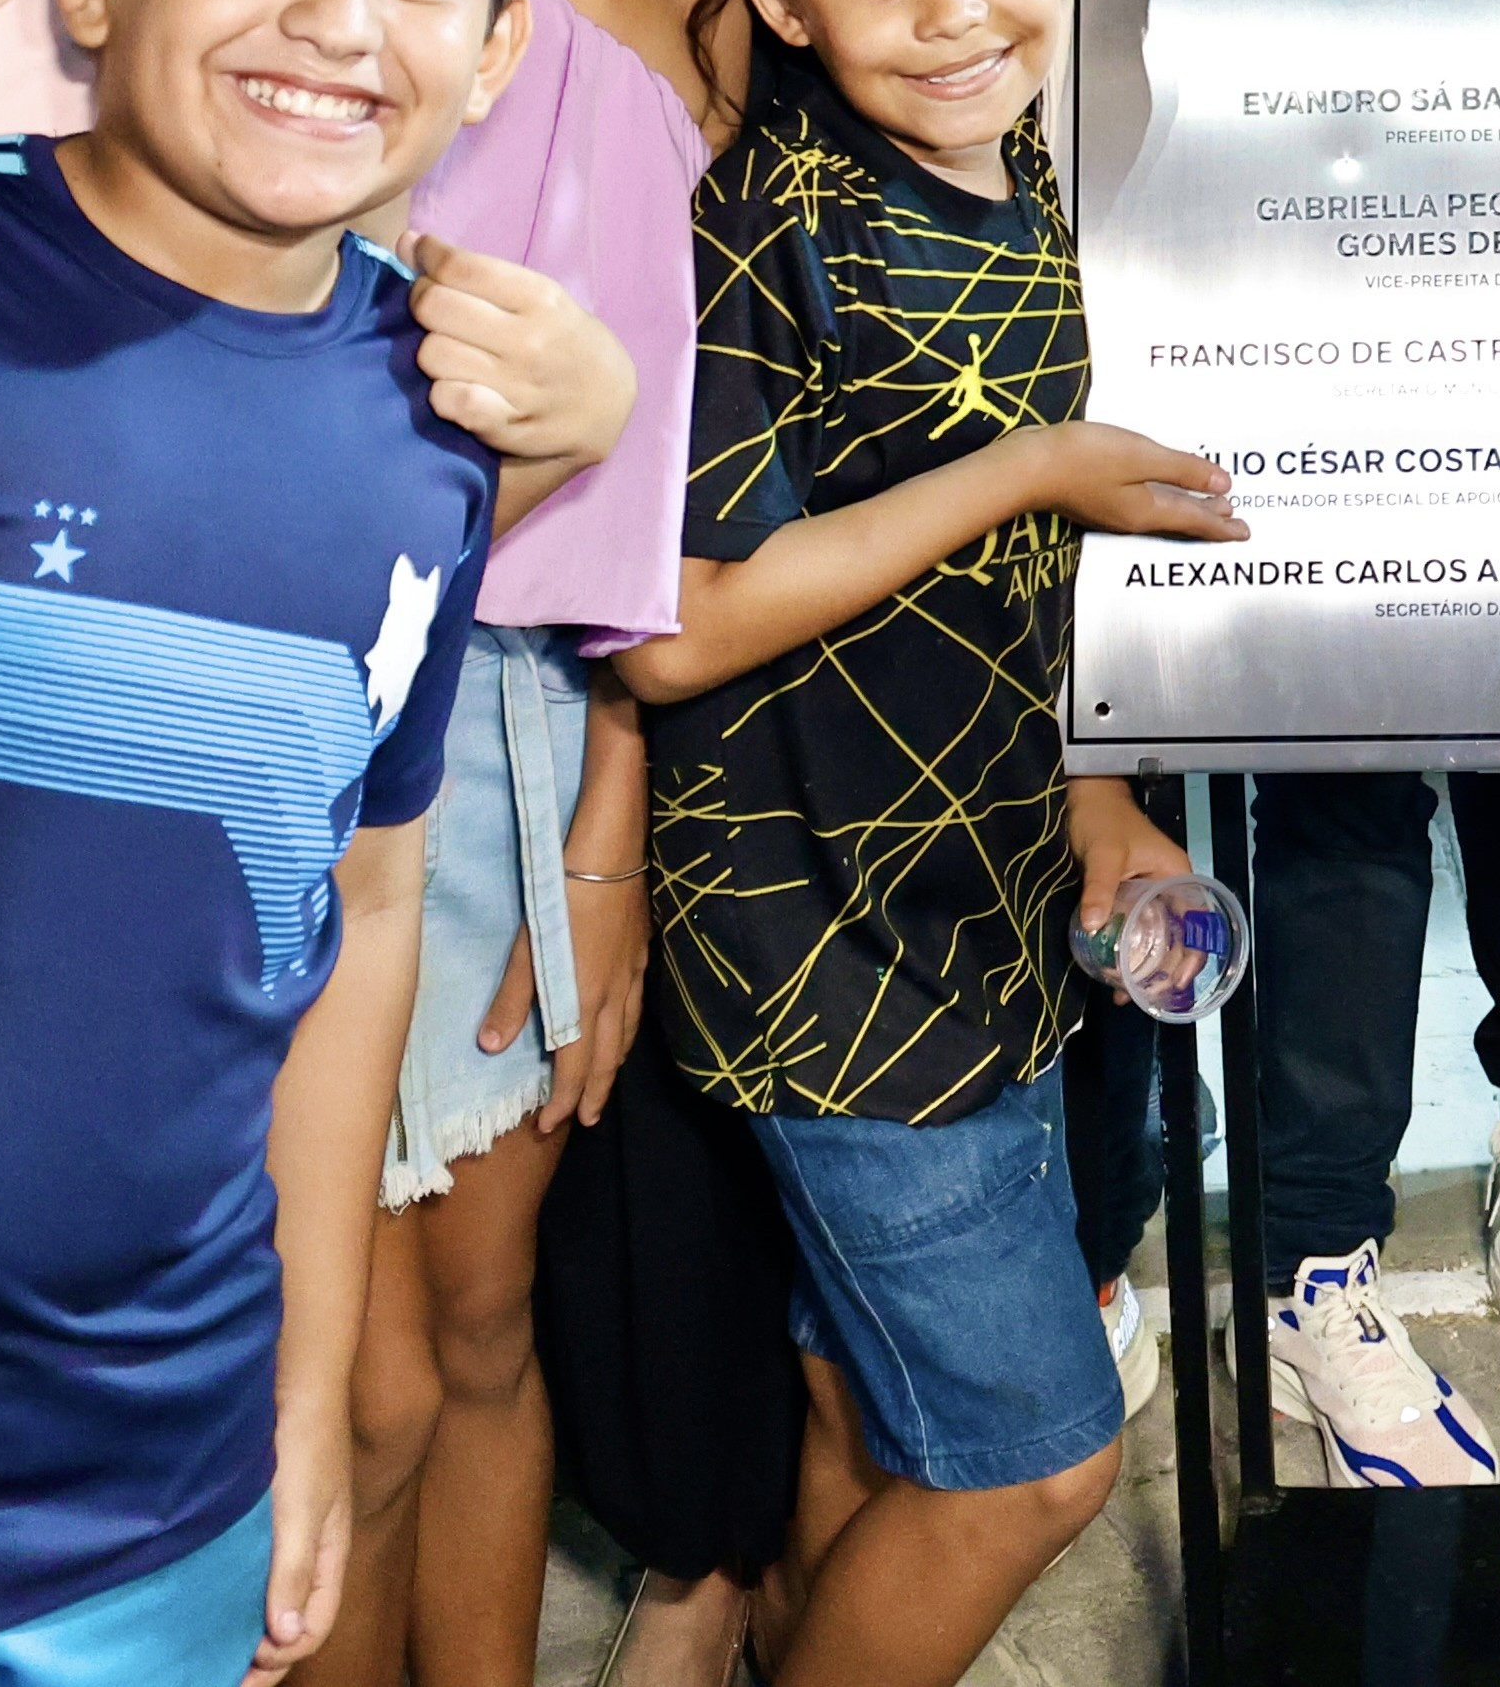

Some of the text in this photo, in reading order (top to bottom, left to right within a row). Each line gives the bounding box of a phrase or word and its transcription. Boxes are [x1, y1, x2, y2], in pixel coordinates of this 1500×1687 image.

[1243, 89, 1401, 116] EVANDRO
[1411, 80, 1453, 111] SÁ
[1386, 129, 1466, 144] PREFEITO
[1471, 129, 1494, 142] DE
[1256, 193, 1438, 222] GABRIELLA
[1336, 230, 1457, 257] GOMES
[1365, 274, 1490, 289] VICE-PREFEITA
[1150, 342, 1340, 367] FRANCISCO
[1352, 341, 1392, 364] DE
[1276, 442, 1385, 475] CÉSAR
[1344, 493, 1423, 507] ESPECIAL
[1429, 493, 1449, 505] DE
[1126, 561, 1324, 588] ALEXANDRE
[1336, 559, 1467, 585] CARLOS
[1375, 599, 1482, 618] SECRETÁRIO
